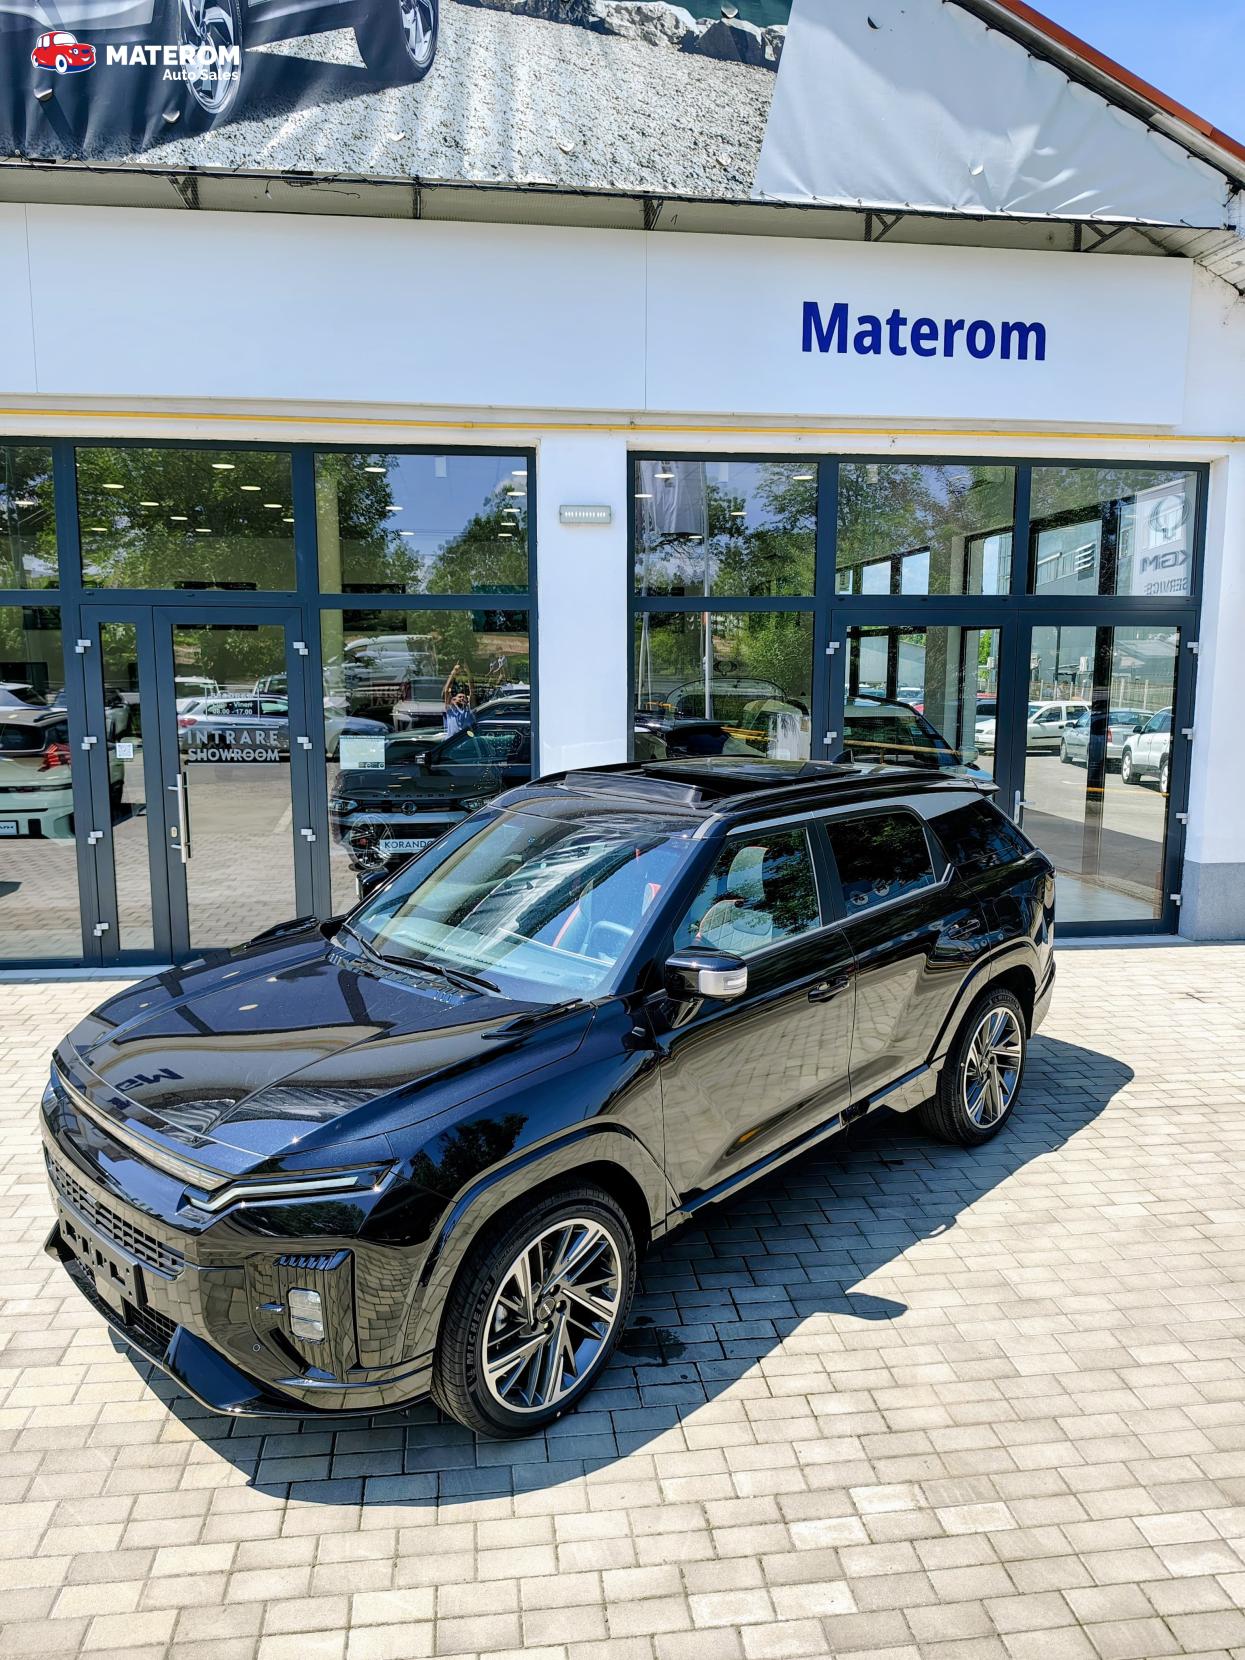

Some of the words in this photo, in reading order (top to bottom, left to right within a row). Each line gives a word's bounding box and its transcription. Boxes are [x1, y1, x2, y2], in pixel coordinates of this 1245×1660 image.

[801, 300, 1046, 361] Materom
[187, 730, 279, 745] INTRARE
[188, 748, 280, 761] SHOWROOM
[467, 1279, 493, 1365] MICHELIN
